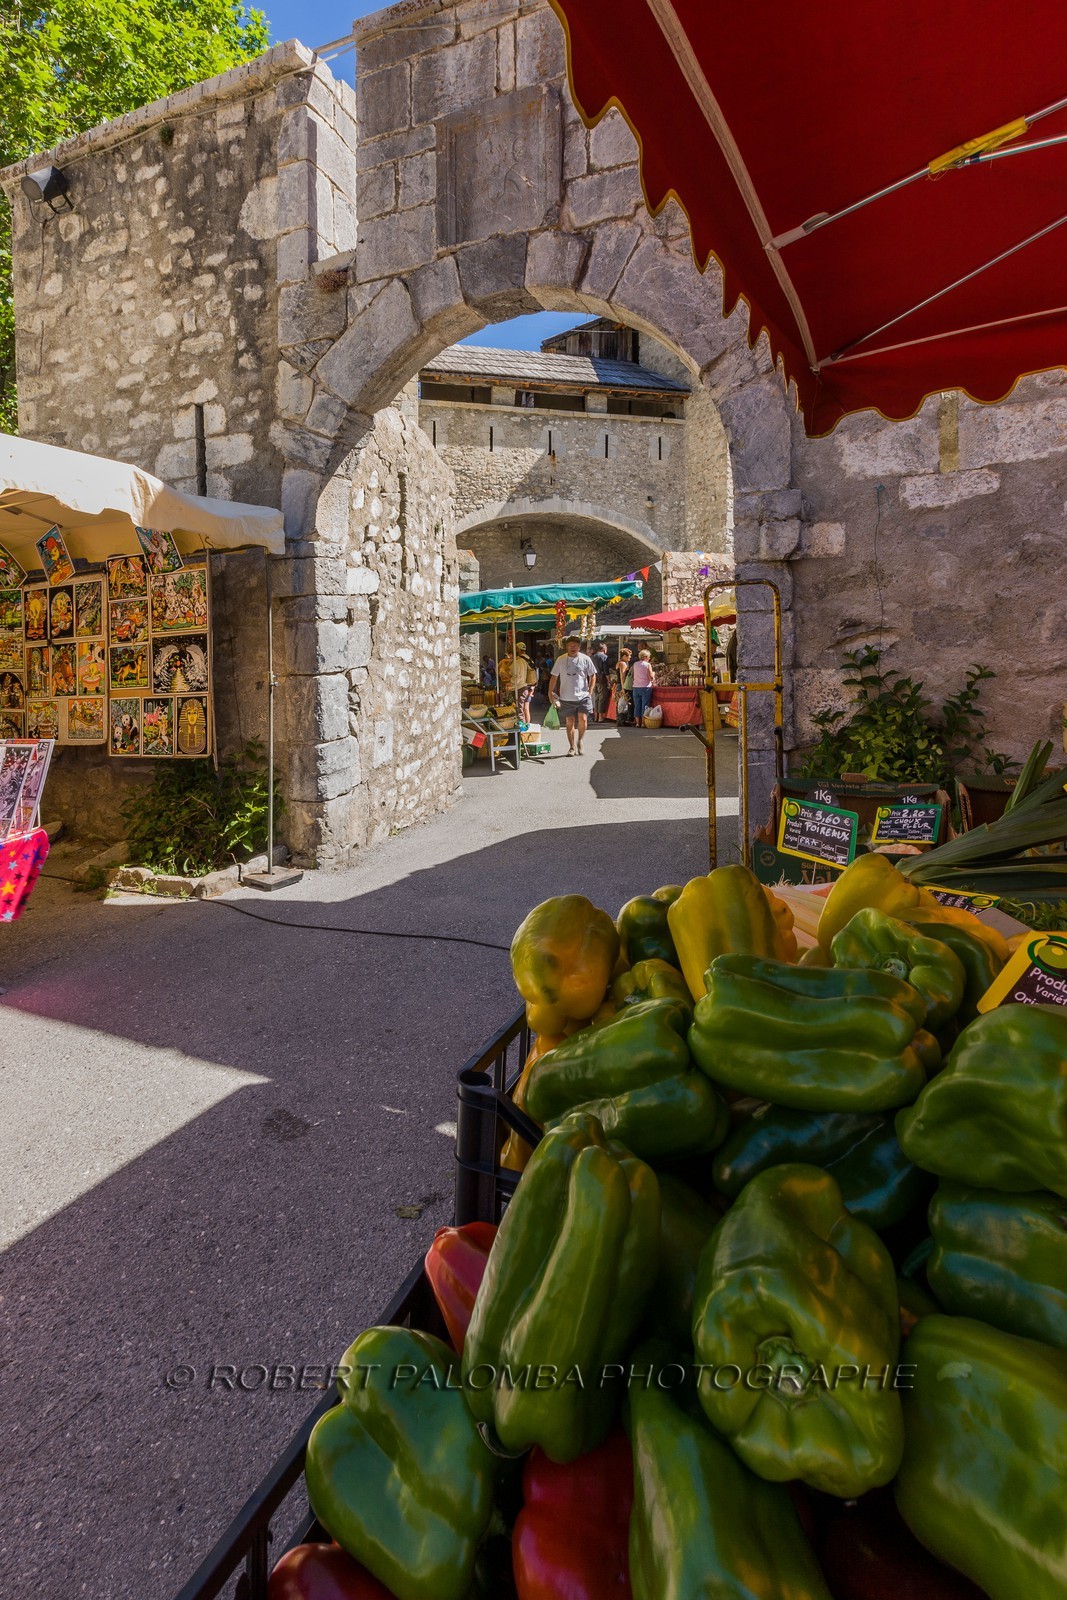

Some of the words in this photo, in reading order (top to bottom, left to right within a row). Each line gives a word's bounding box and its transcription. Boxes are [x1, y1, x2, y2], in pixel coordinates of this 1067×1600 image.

[801, 808, 812, 818] Prix
[844, 818, 850, 826] €
[800, 837, 818, 846] FRA
[1014, 991, 1040, 1005] Ori
